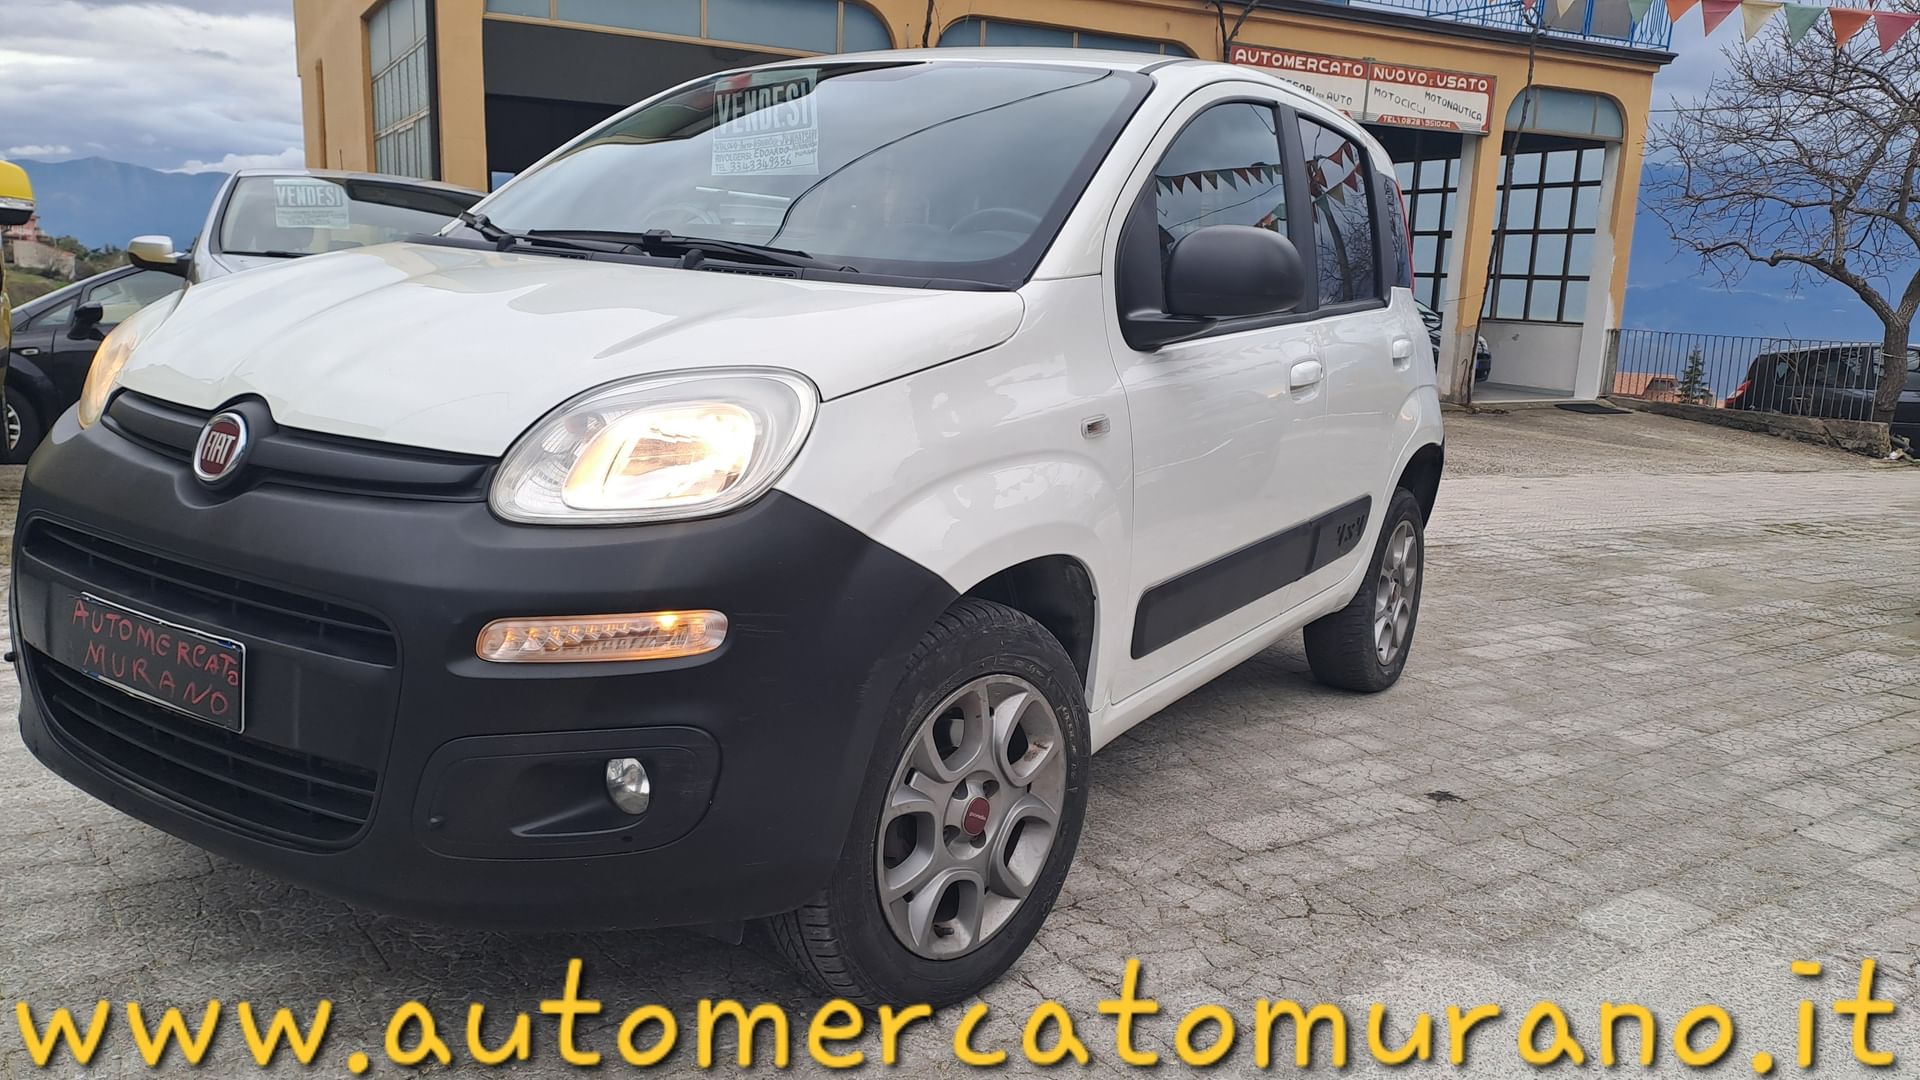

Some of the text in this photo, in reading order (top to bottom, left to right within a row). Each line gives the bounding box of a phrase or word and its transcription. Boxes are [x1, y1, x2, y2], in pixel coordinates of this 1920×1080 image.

[1235, 49, 1364, 77] AUTOMERCATO
[1373, 67, 1428, 86] NUOVO
[1436, 75, 1489, 92] USATO
[716, 82, 809, 134] VENDESI
[1326, 91, 1353, 106] AUTO
[1374, 87, 1426, 115] MOTOCICLI
[1424, 91, 1482, 122] MOTONAUTICA
[276, 185, 342, 207] VENDESI
[202, 430, 237, 465] FIAT
[83, 640, 229, 716] MURANO
